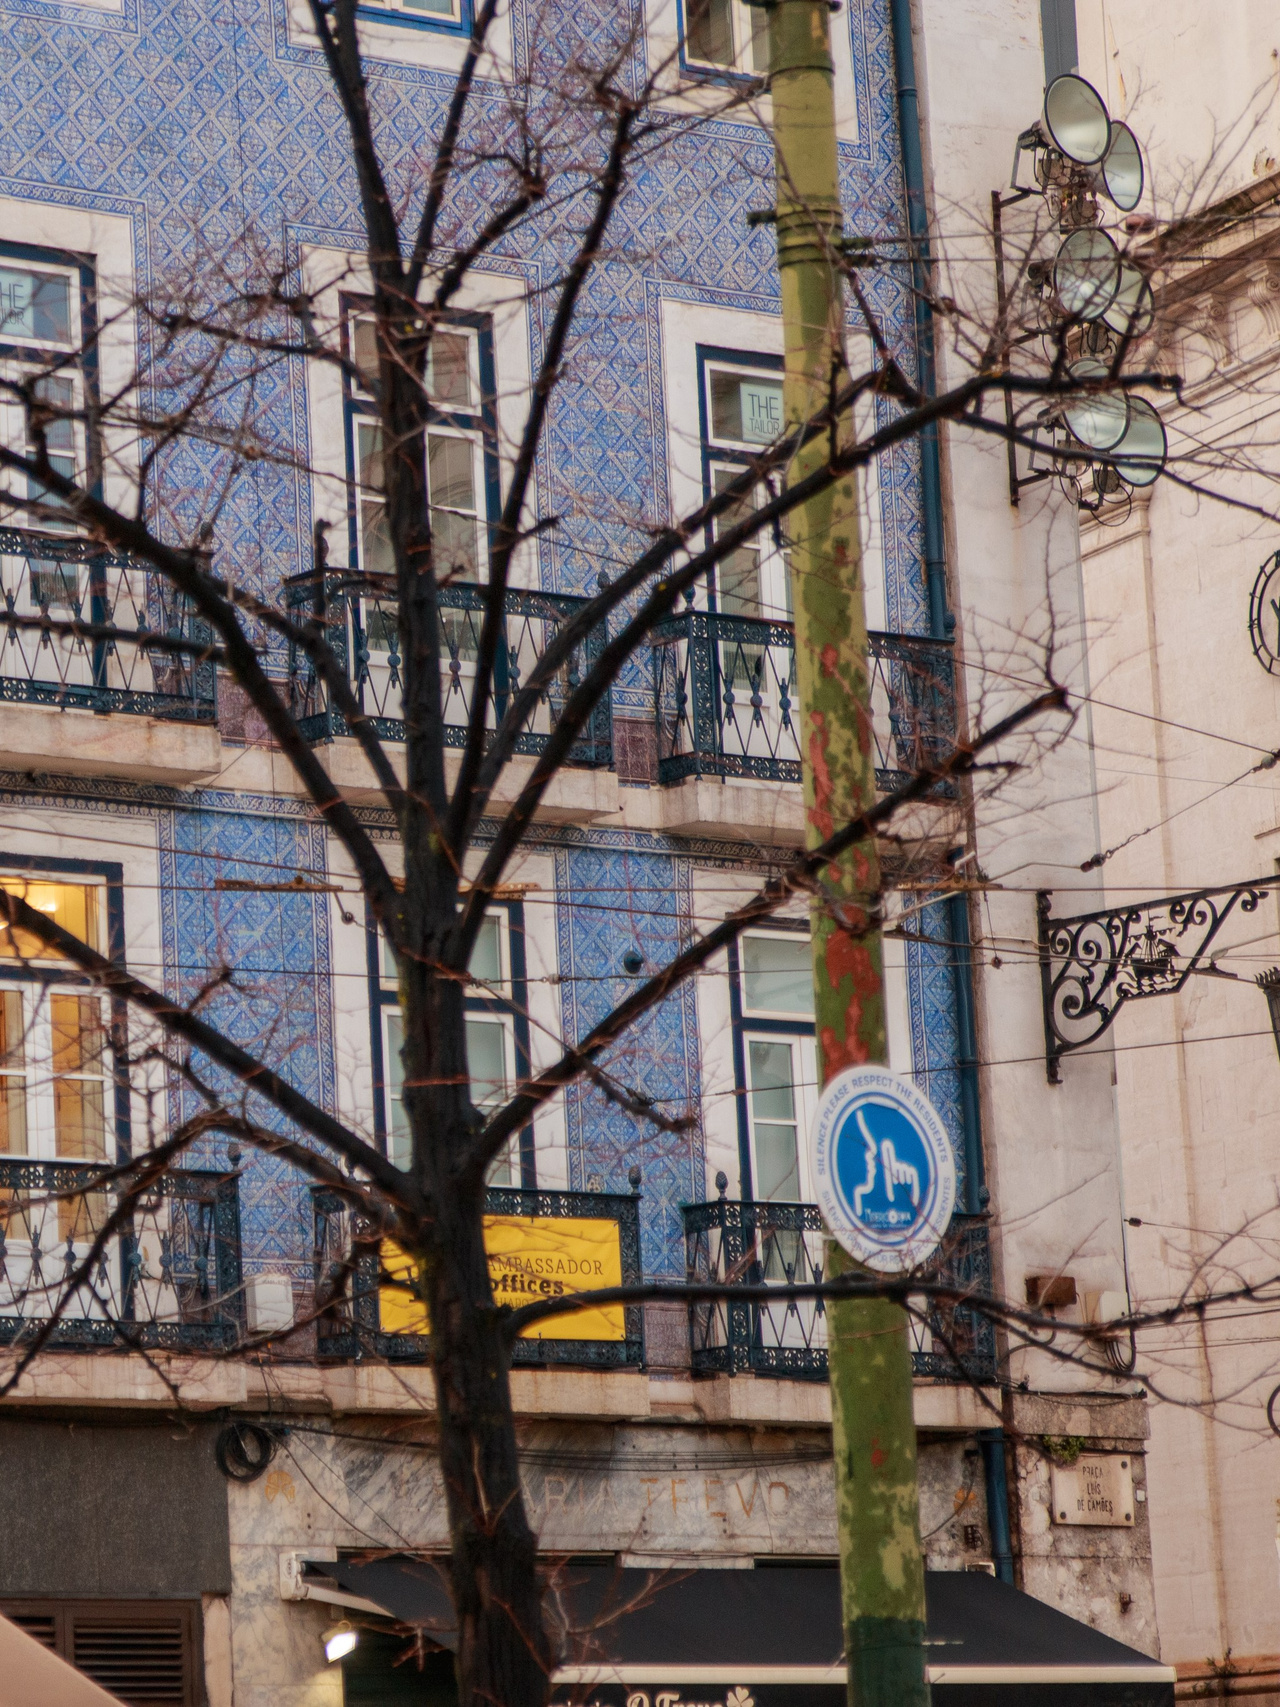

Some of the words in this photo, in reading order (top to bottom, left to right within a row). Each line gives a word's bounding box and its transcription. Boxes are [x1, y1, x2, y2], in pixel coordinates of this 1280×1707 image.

[747, 393, 780, 421] THE
[749, 417, 780, 436] TAILOR
[818, 1124, 829, 1175] SILENCE
[824, 1084, 850, 1122] PLEASE
[851, 1075, 893, 1089] RESPECT
[895, 1082, 914, 1101] THE
[913, 1097, 949, 1163] RESIDENTS
[486, 1257, 603, 1276] AMBASSADOR
[489, 1273, 565, 1296] offices
[1077, 1498, 1085, 1512] DE
